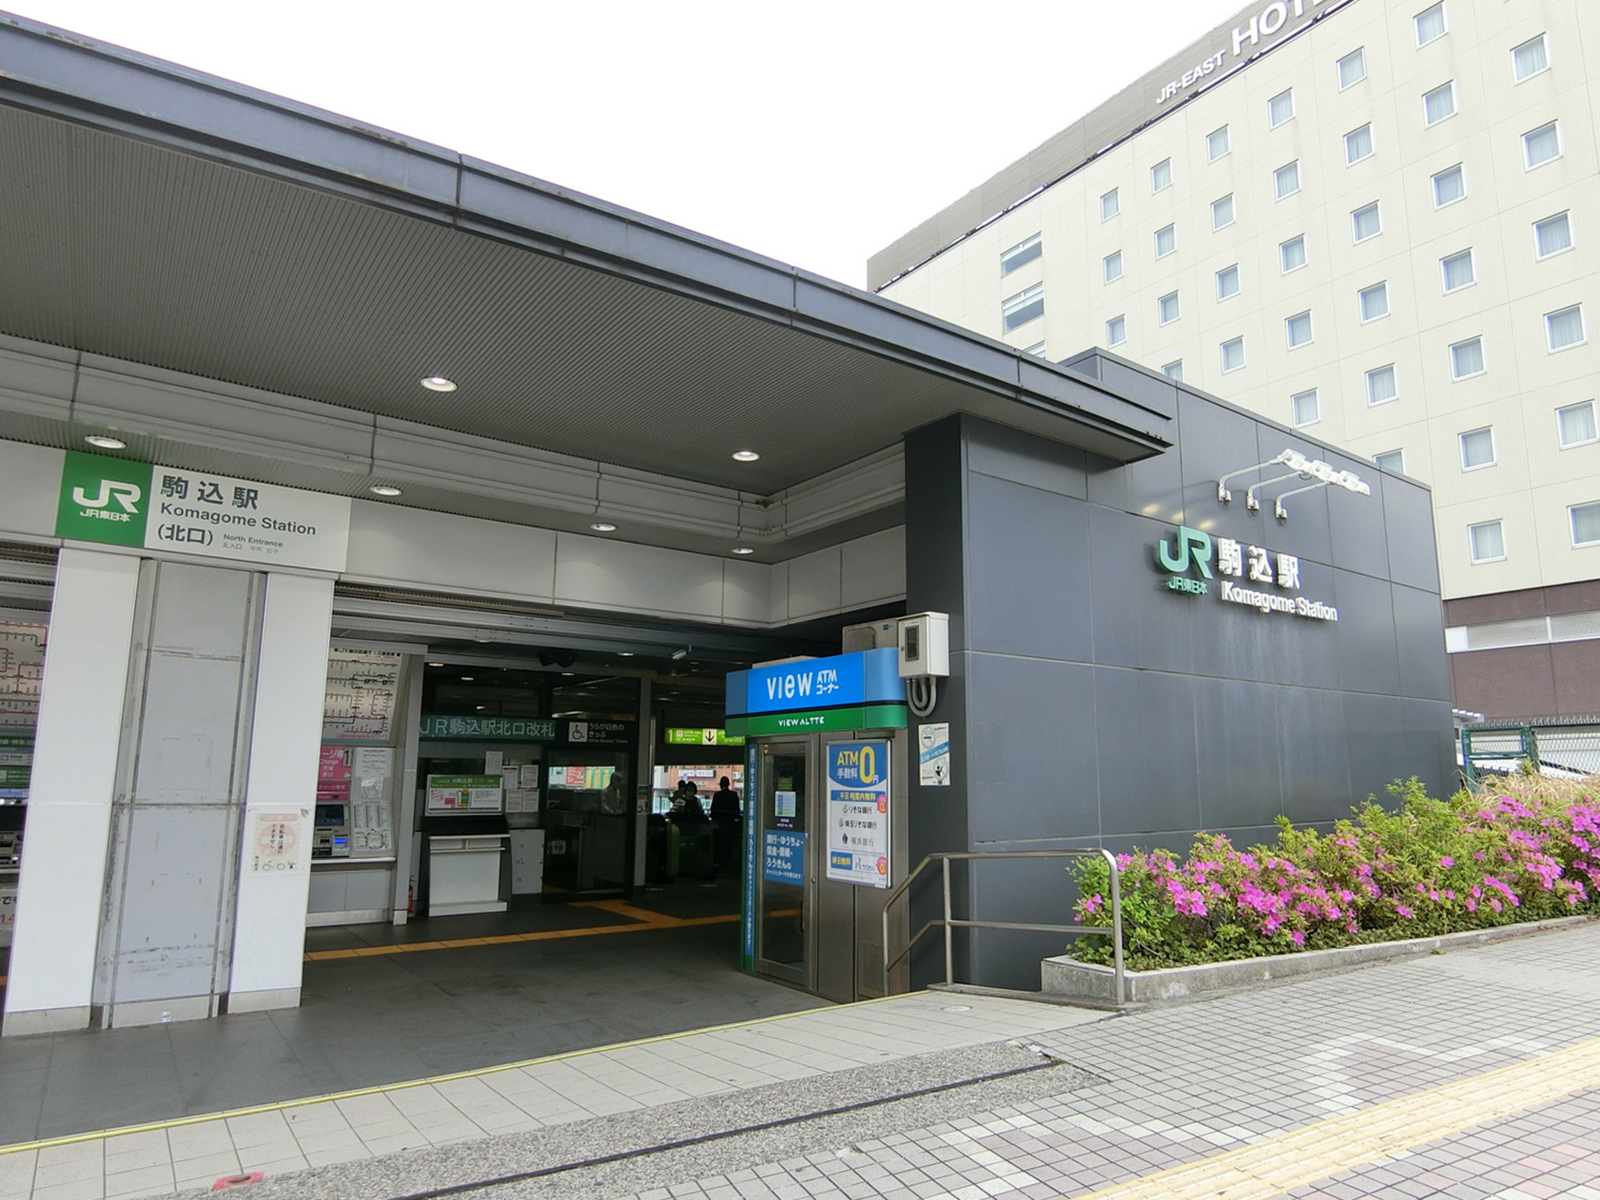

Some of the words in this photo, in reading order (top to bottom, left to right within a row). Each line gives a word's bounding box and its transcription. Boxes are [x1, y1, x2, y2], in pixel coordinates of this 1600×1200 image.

[1156, 49, 1227, 104] JR-EAST
[73, 480, 141, 514] JR
[160, 475, 259, 511] 駒込駅
[80, 509, 131, 523] JR東日本
[160, 502, 257, 528] Komagome
[261, 517, 316, 536] Station
[157, 524, 214, 546] (北口)
[223, 533, 246, 543] North
[248, 537, 284, 547] Entrance
[1158, 525, 1214, 579] JR
[1217, 537, 1301, 590] 駒込駅
[1166, 576, 1209, 595] JR東日本
[1221, 580, 1296, 614] Komagome
[1296, 596, 1339, 622] Station
[816, 669, 838, 684] ATM
[816, 683, 840, 695] コーナー
[778, 718, 800, 727] VIEW
[667, 728, 673, 742] 1
[837, 751, 858, 766] ATM
